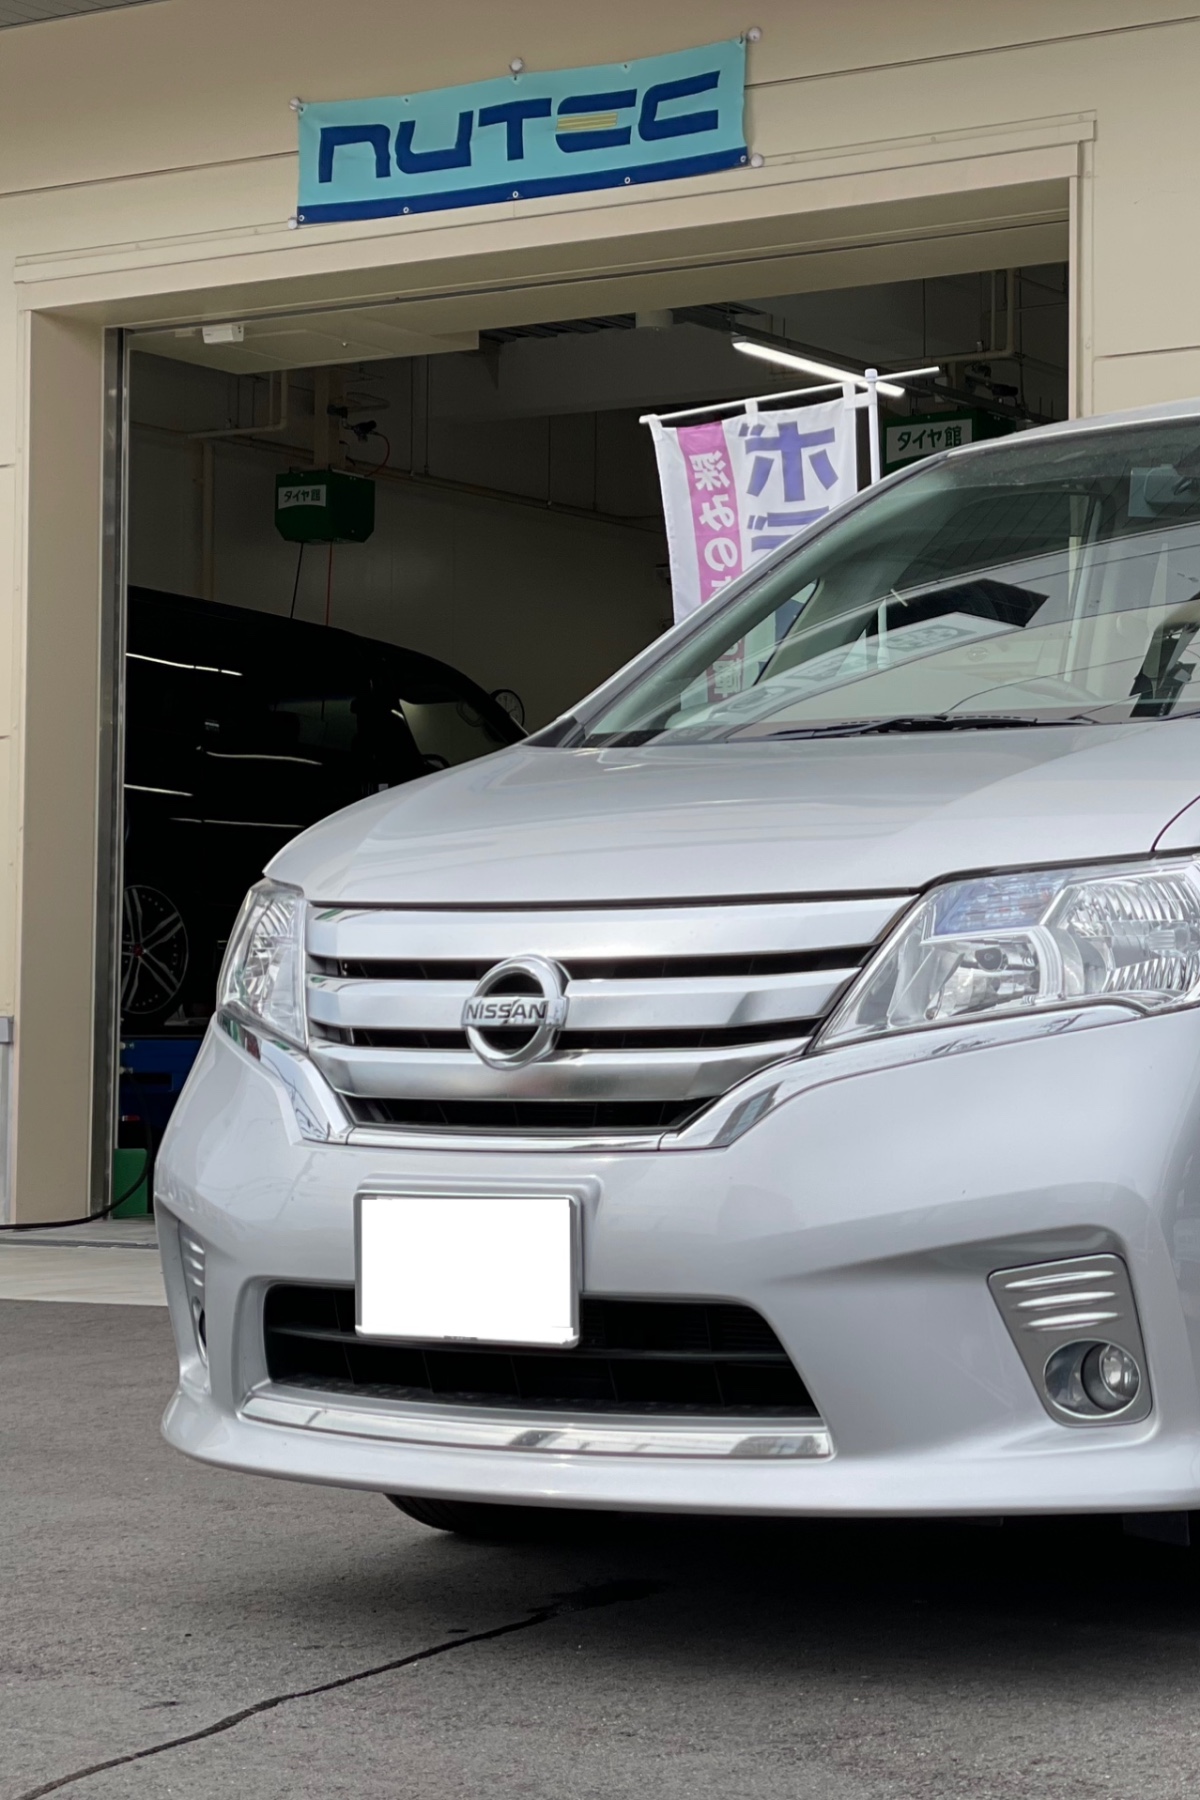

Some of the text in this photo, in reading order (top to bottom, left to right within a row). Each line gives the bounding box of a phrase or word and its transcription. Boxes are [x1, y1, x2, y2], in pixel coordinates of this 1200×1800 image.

[318, 70, 721, 183] NUTEC
[897, 425, 962, 452] タイヤ館
[466, 1003, 547, 1019] NISSAN
